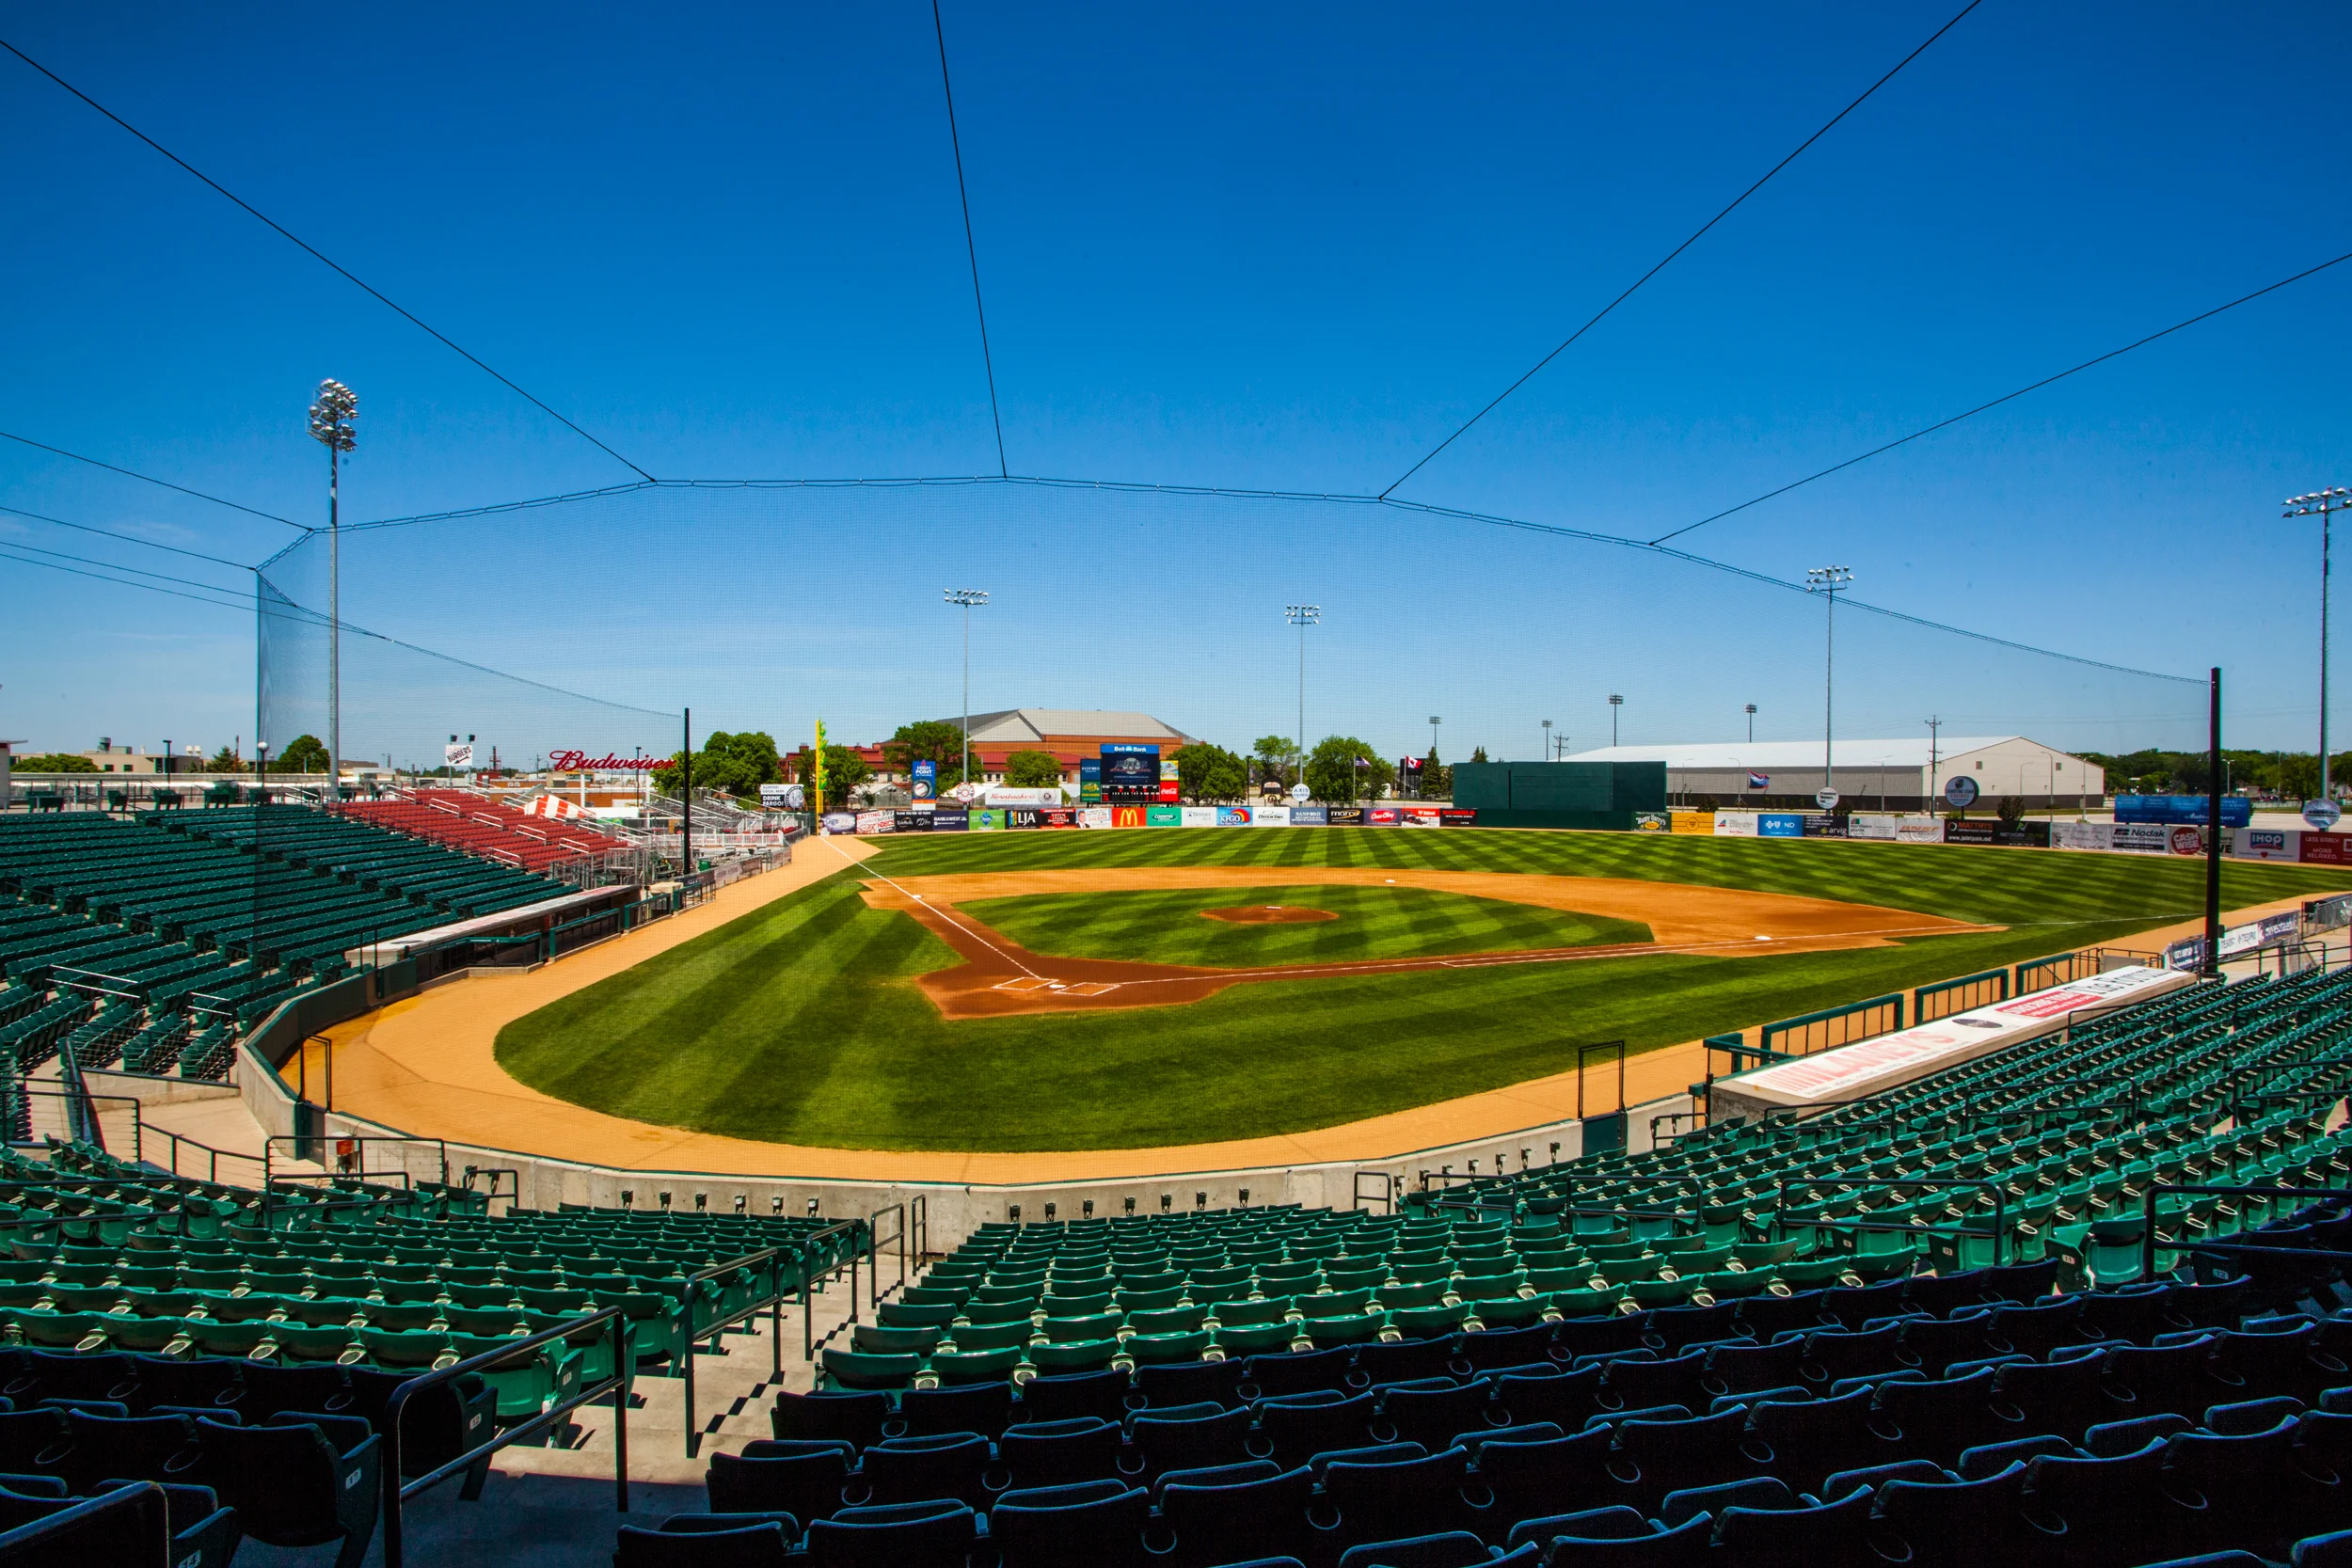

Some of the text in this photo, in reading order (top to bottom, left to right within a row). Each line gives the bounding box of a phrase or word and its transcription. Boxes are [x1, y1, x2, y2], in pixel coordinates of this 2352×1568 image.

[447, 746, 471, 762] BURGERS
[549, 750, 676, 771] Budweiser
[1018, 813, 1036, 826] LJA
[1829, 827, 1847, 835] arvig
[2173, 832, 2199, 842] CASH
[2177, 840, 2200, 849] WISE
[2201, 844, 2233, 853] SVE
